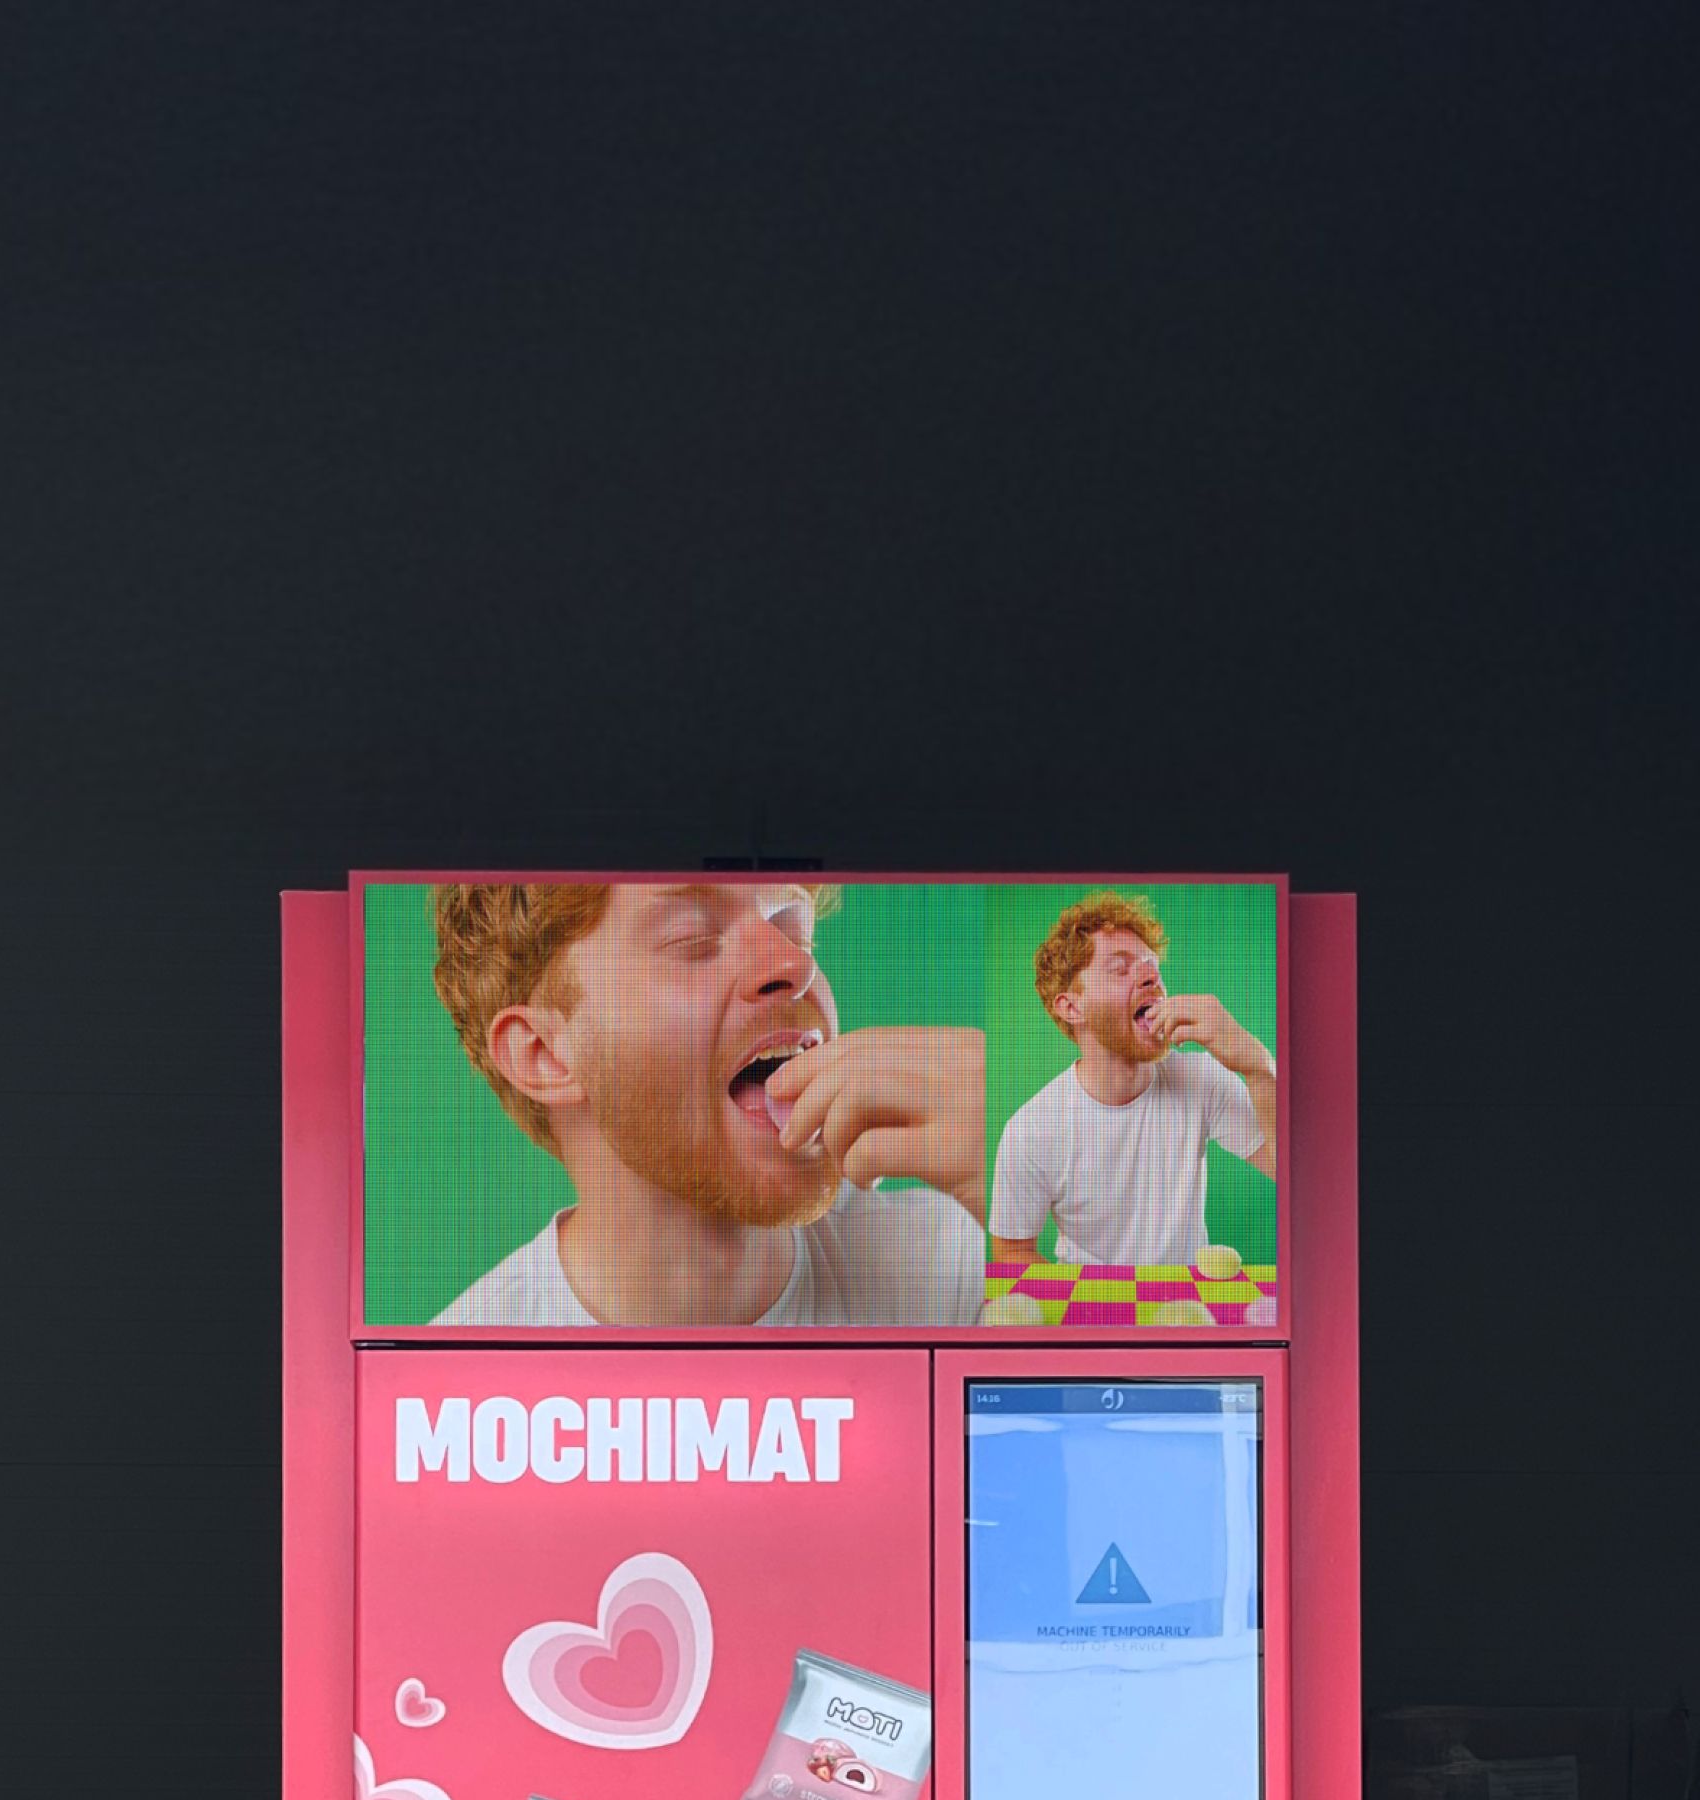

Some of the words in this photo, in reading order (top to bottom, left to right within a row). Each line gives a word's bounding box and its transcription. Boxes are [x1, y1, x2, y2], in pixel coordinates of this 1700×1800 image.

[395, 1396, 854, 1484] MOCHIMAT
[1037, 1625, 1097, 1637] MACHINE
[1101, 1625, 1192, 1637] TEMPORARILY
[1114, 1640, 1168, 1652] SERVICE
[827, 1696, 902, 1740] MOTI
